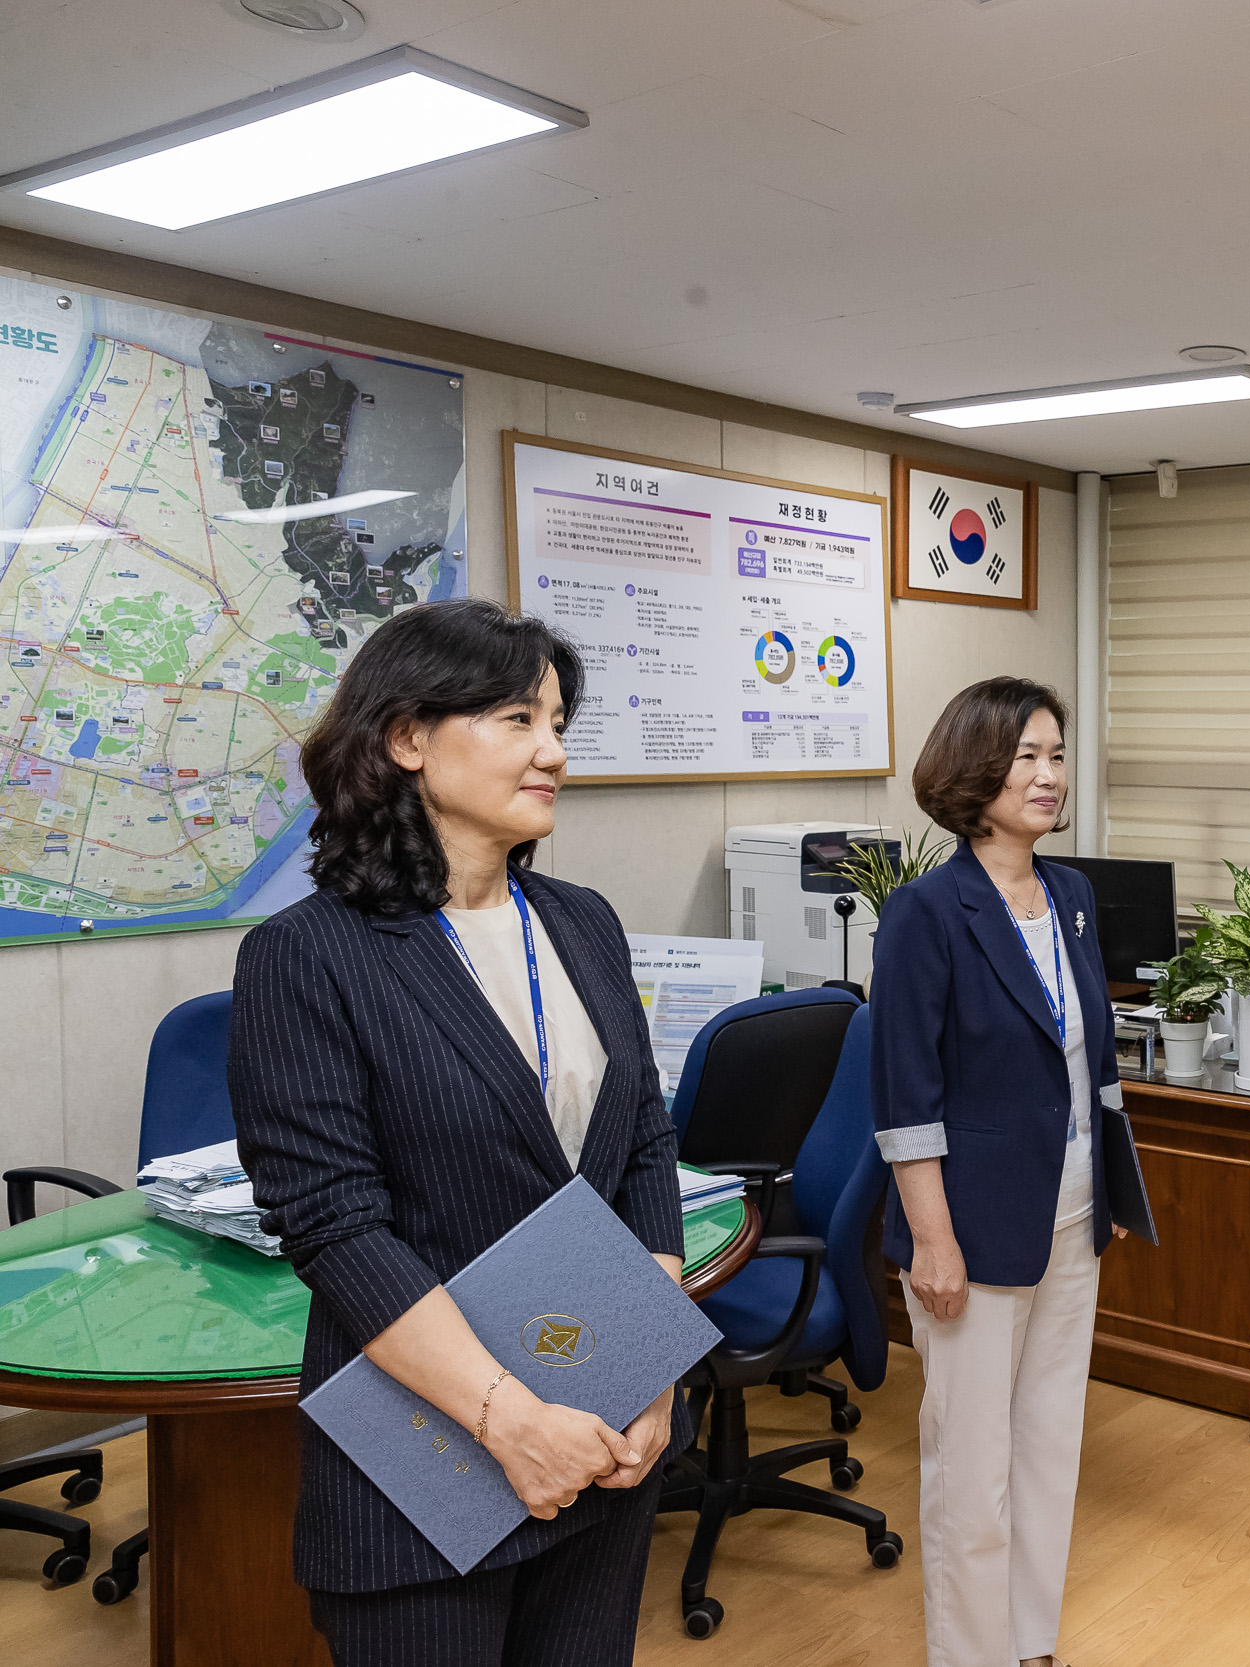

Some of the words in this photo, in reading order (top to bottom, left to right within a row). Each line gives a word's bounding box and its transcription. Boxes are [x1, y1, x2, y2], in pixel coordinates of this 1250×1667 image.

[596, 472, 659, 497] 지역여건
[778, 502, 828, 523] 재정현황
[764, 535, 776, 544] 예산
[815, 542, 826, 550] 기금
[639, 647, 660, 656] 기간시설
[411, 1410, 470, 1474] 광진구
